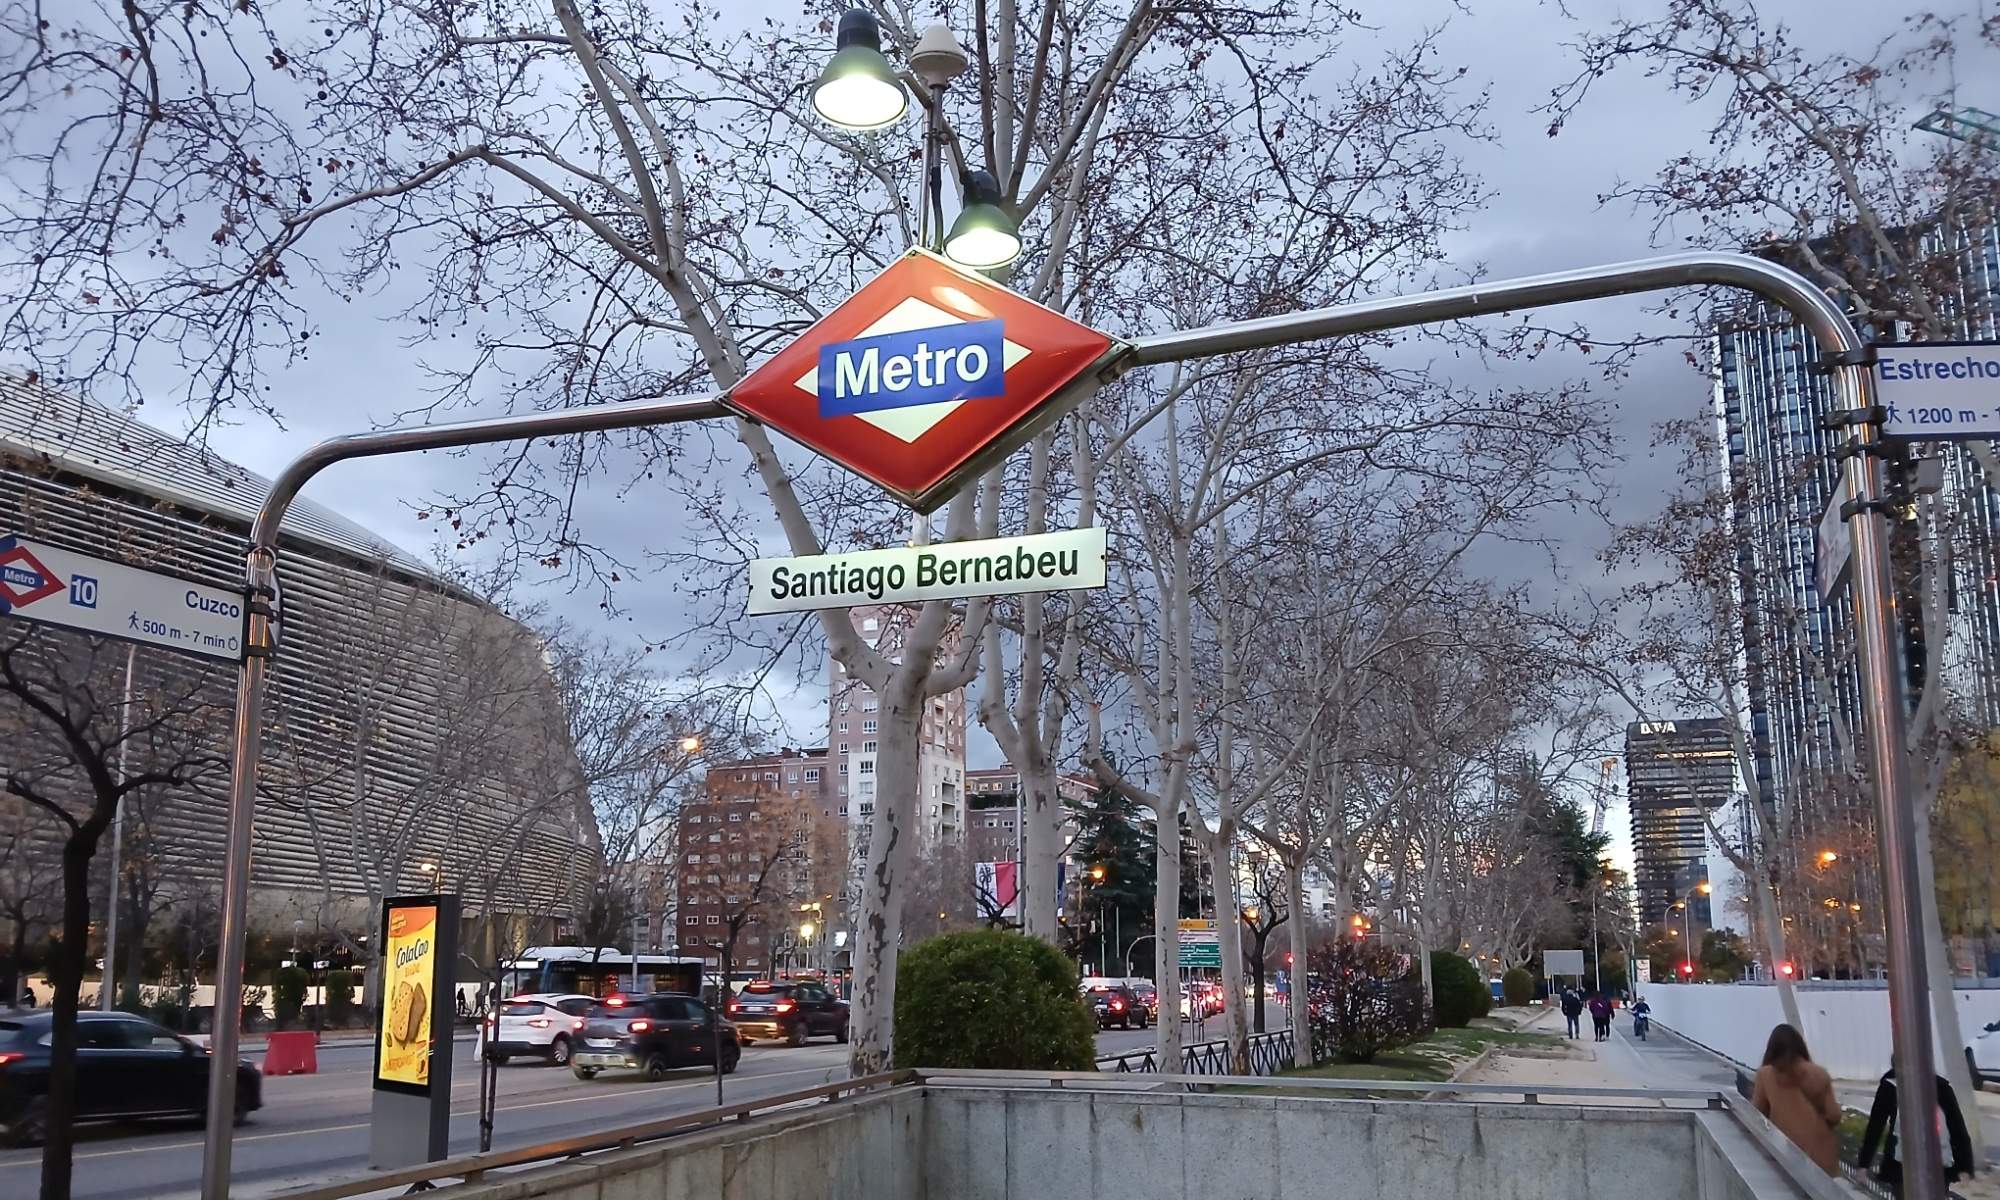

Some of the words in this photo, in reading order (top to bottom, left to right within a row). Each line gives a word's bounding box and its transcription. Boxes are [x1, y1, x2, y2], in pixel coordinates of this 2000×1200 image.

[834, 342, 989, 399] Metro
[1879, 356, 2000, 380] Estrecho
[1908, 408, 1953, 424] 1200
[1959, 410, 1976, 423] m
[4, 569, 35, 585] Metro
[770, 561, 905, 601] Santiago
[916, 546, 1078, 588] Bernabeu
[71, 579, 96, 604] 10
[185, 590, 240, 618] Cuzco
[143, 620, 166, 636] 500
[170, 628, 181, 639] m
[193, 631, 200, 643] 7
[203, 635, 225, 648] min
[396, 938, 428, 968] ColaCao
